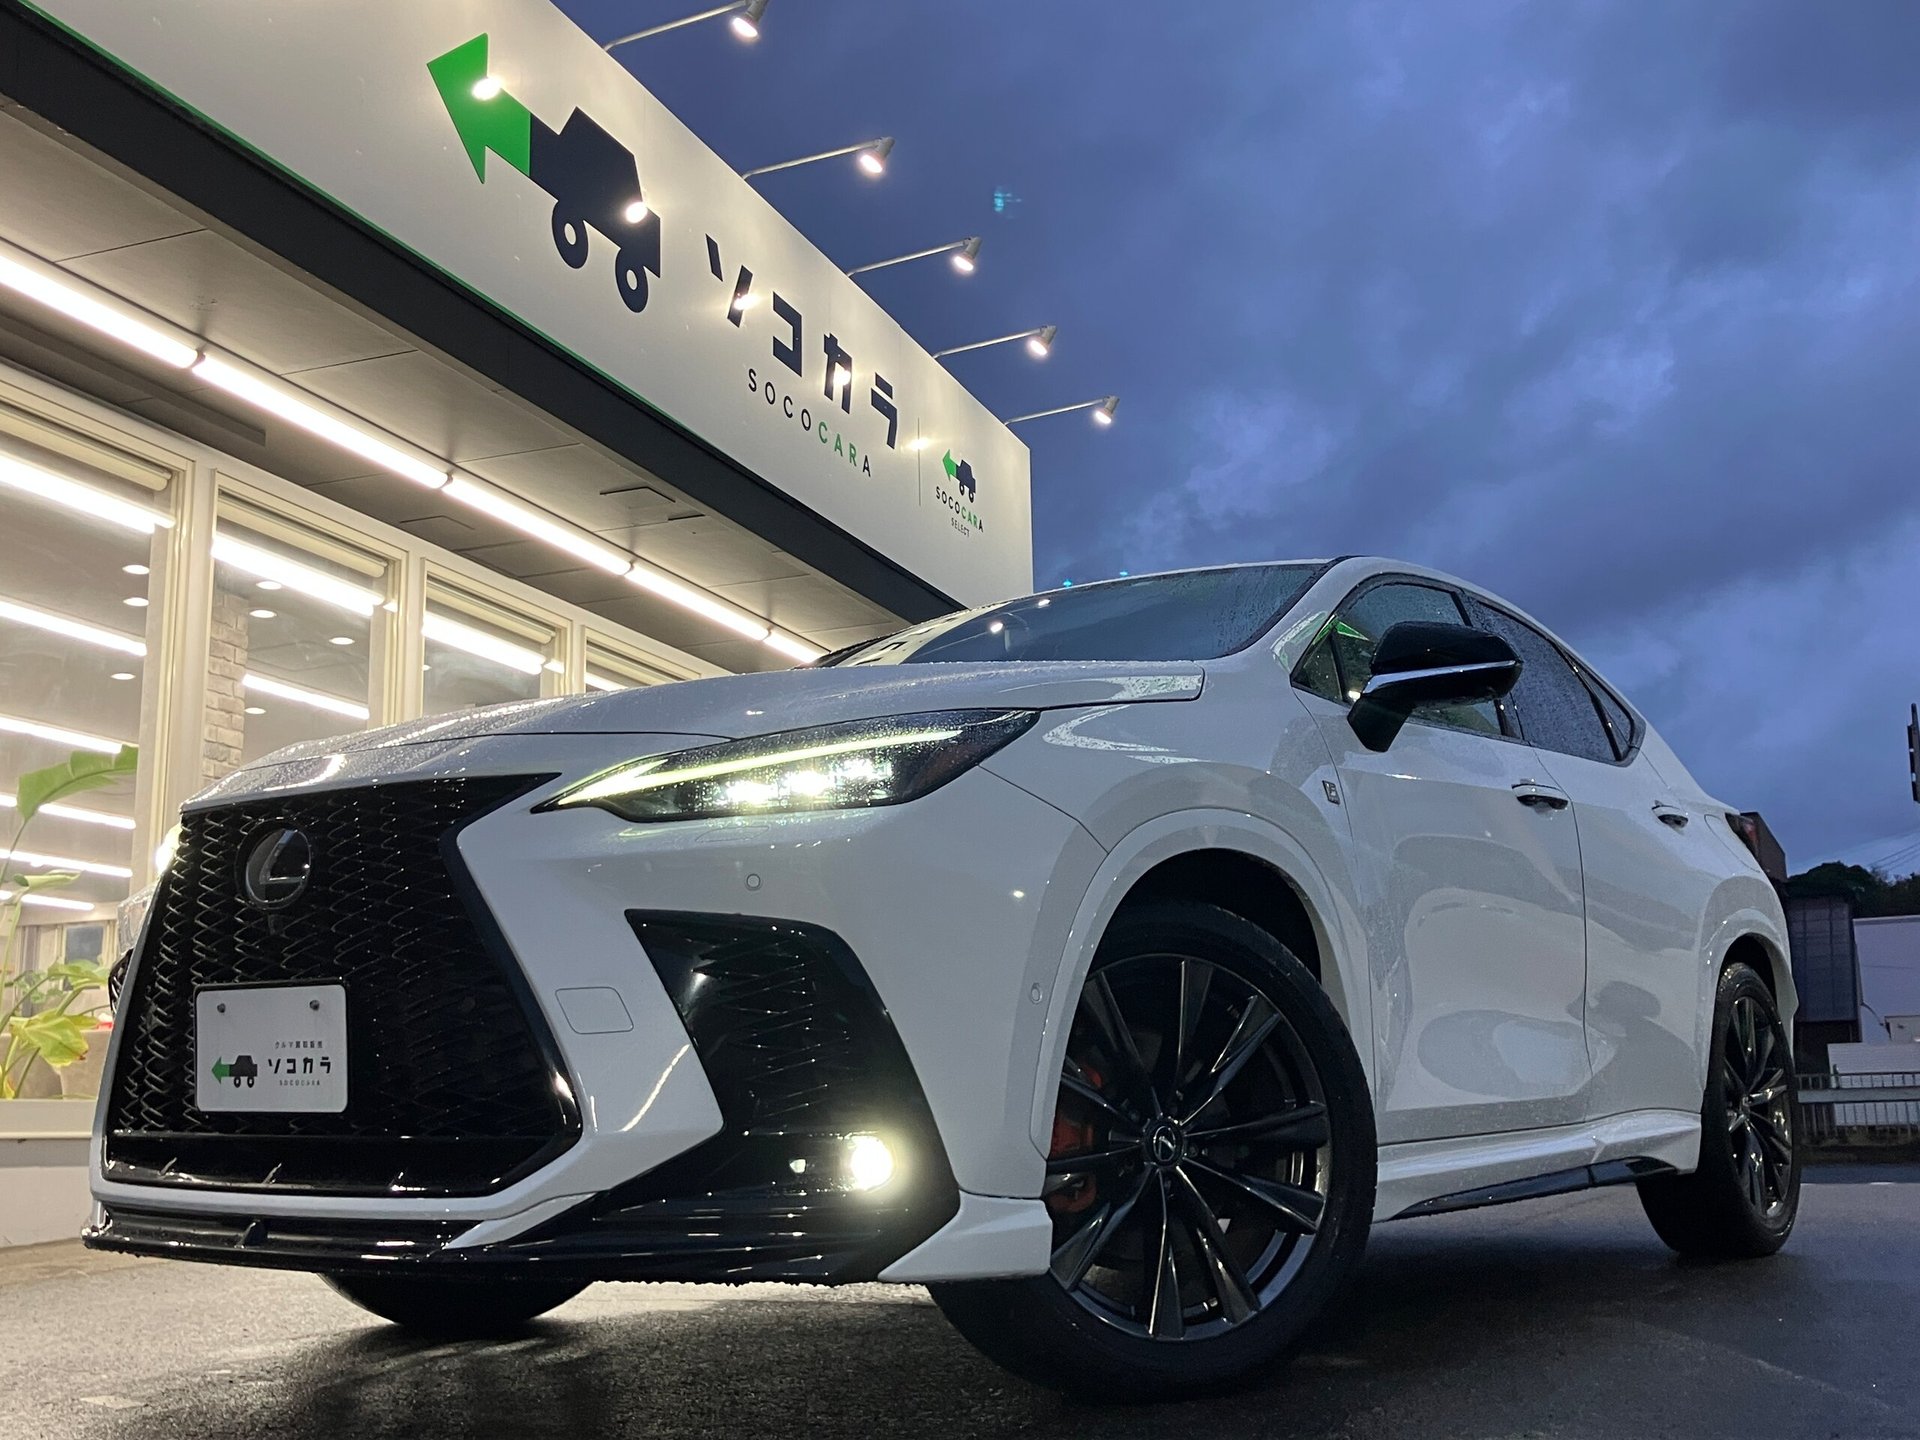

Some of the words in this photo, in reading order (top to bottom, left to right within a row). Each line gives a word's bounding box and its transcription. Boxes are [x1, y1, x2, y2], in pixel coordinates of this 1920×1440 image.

[705, 233, 898, 450] ソコカラ
[748, 368, 871, 478] SOCOCARA
[936, 486, 984, 533] SOCOCARA
[951, 517, 970, 538] SELECT
[267, 1056, 331, 1075] ソコカラ
